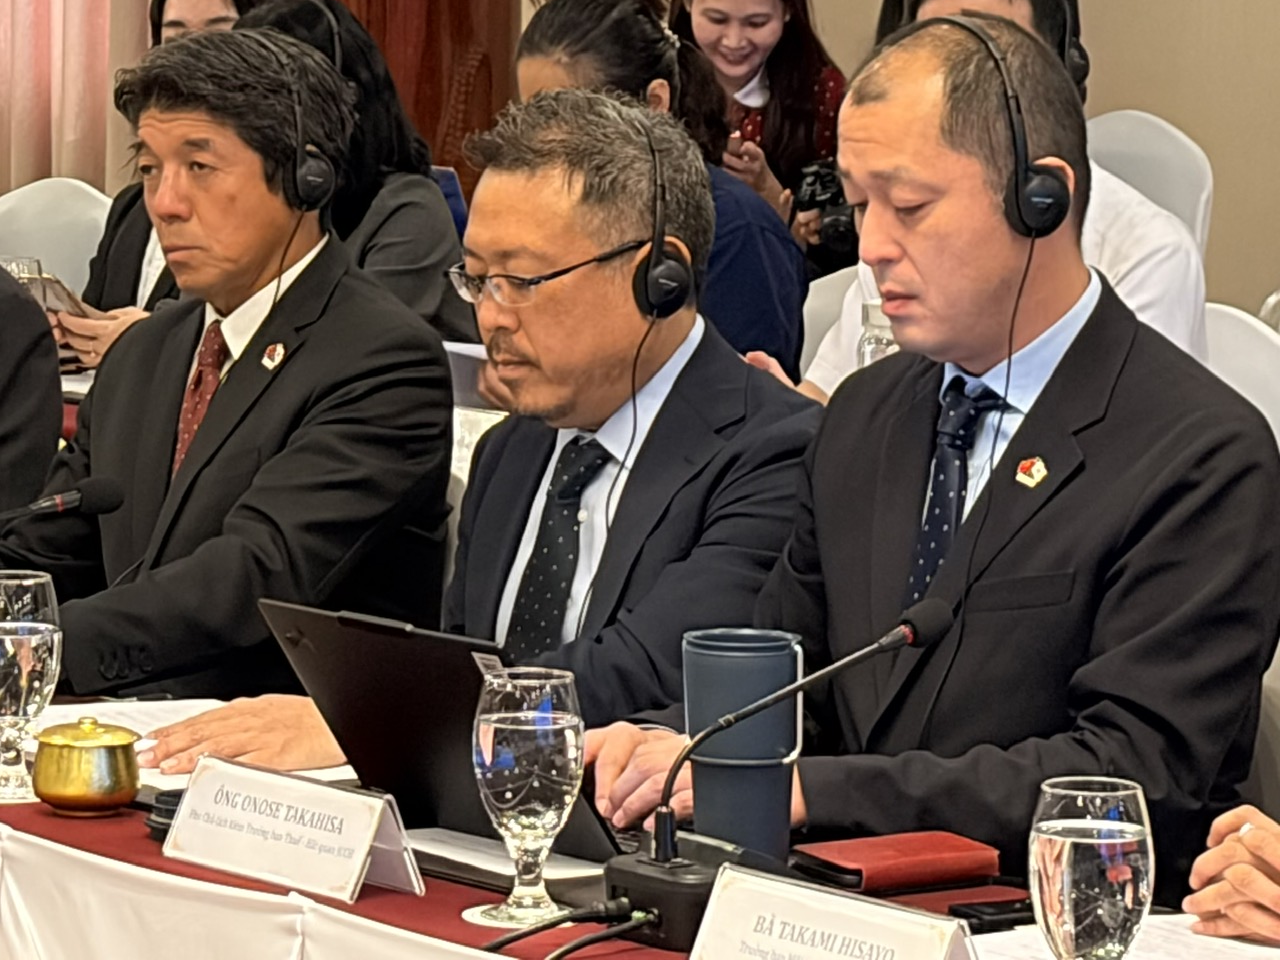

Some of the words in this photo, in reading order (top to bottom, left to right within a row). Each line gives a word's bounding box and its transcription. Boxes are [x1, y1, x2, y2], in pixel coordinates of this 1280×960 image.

[213, 783, 242, 809] ÔNG
[241, 794, 284, 819] ONOSE
[283, 804, 345, 836] TAKAHISA
[753, 912, 776, 936] BÀ
[778, 921, 839, 952] TAKAMI
[838, 934, 896, 960] HISAYO
